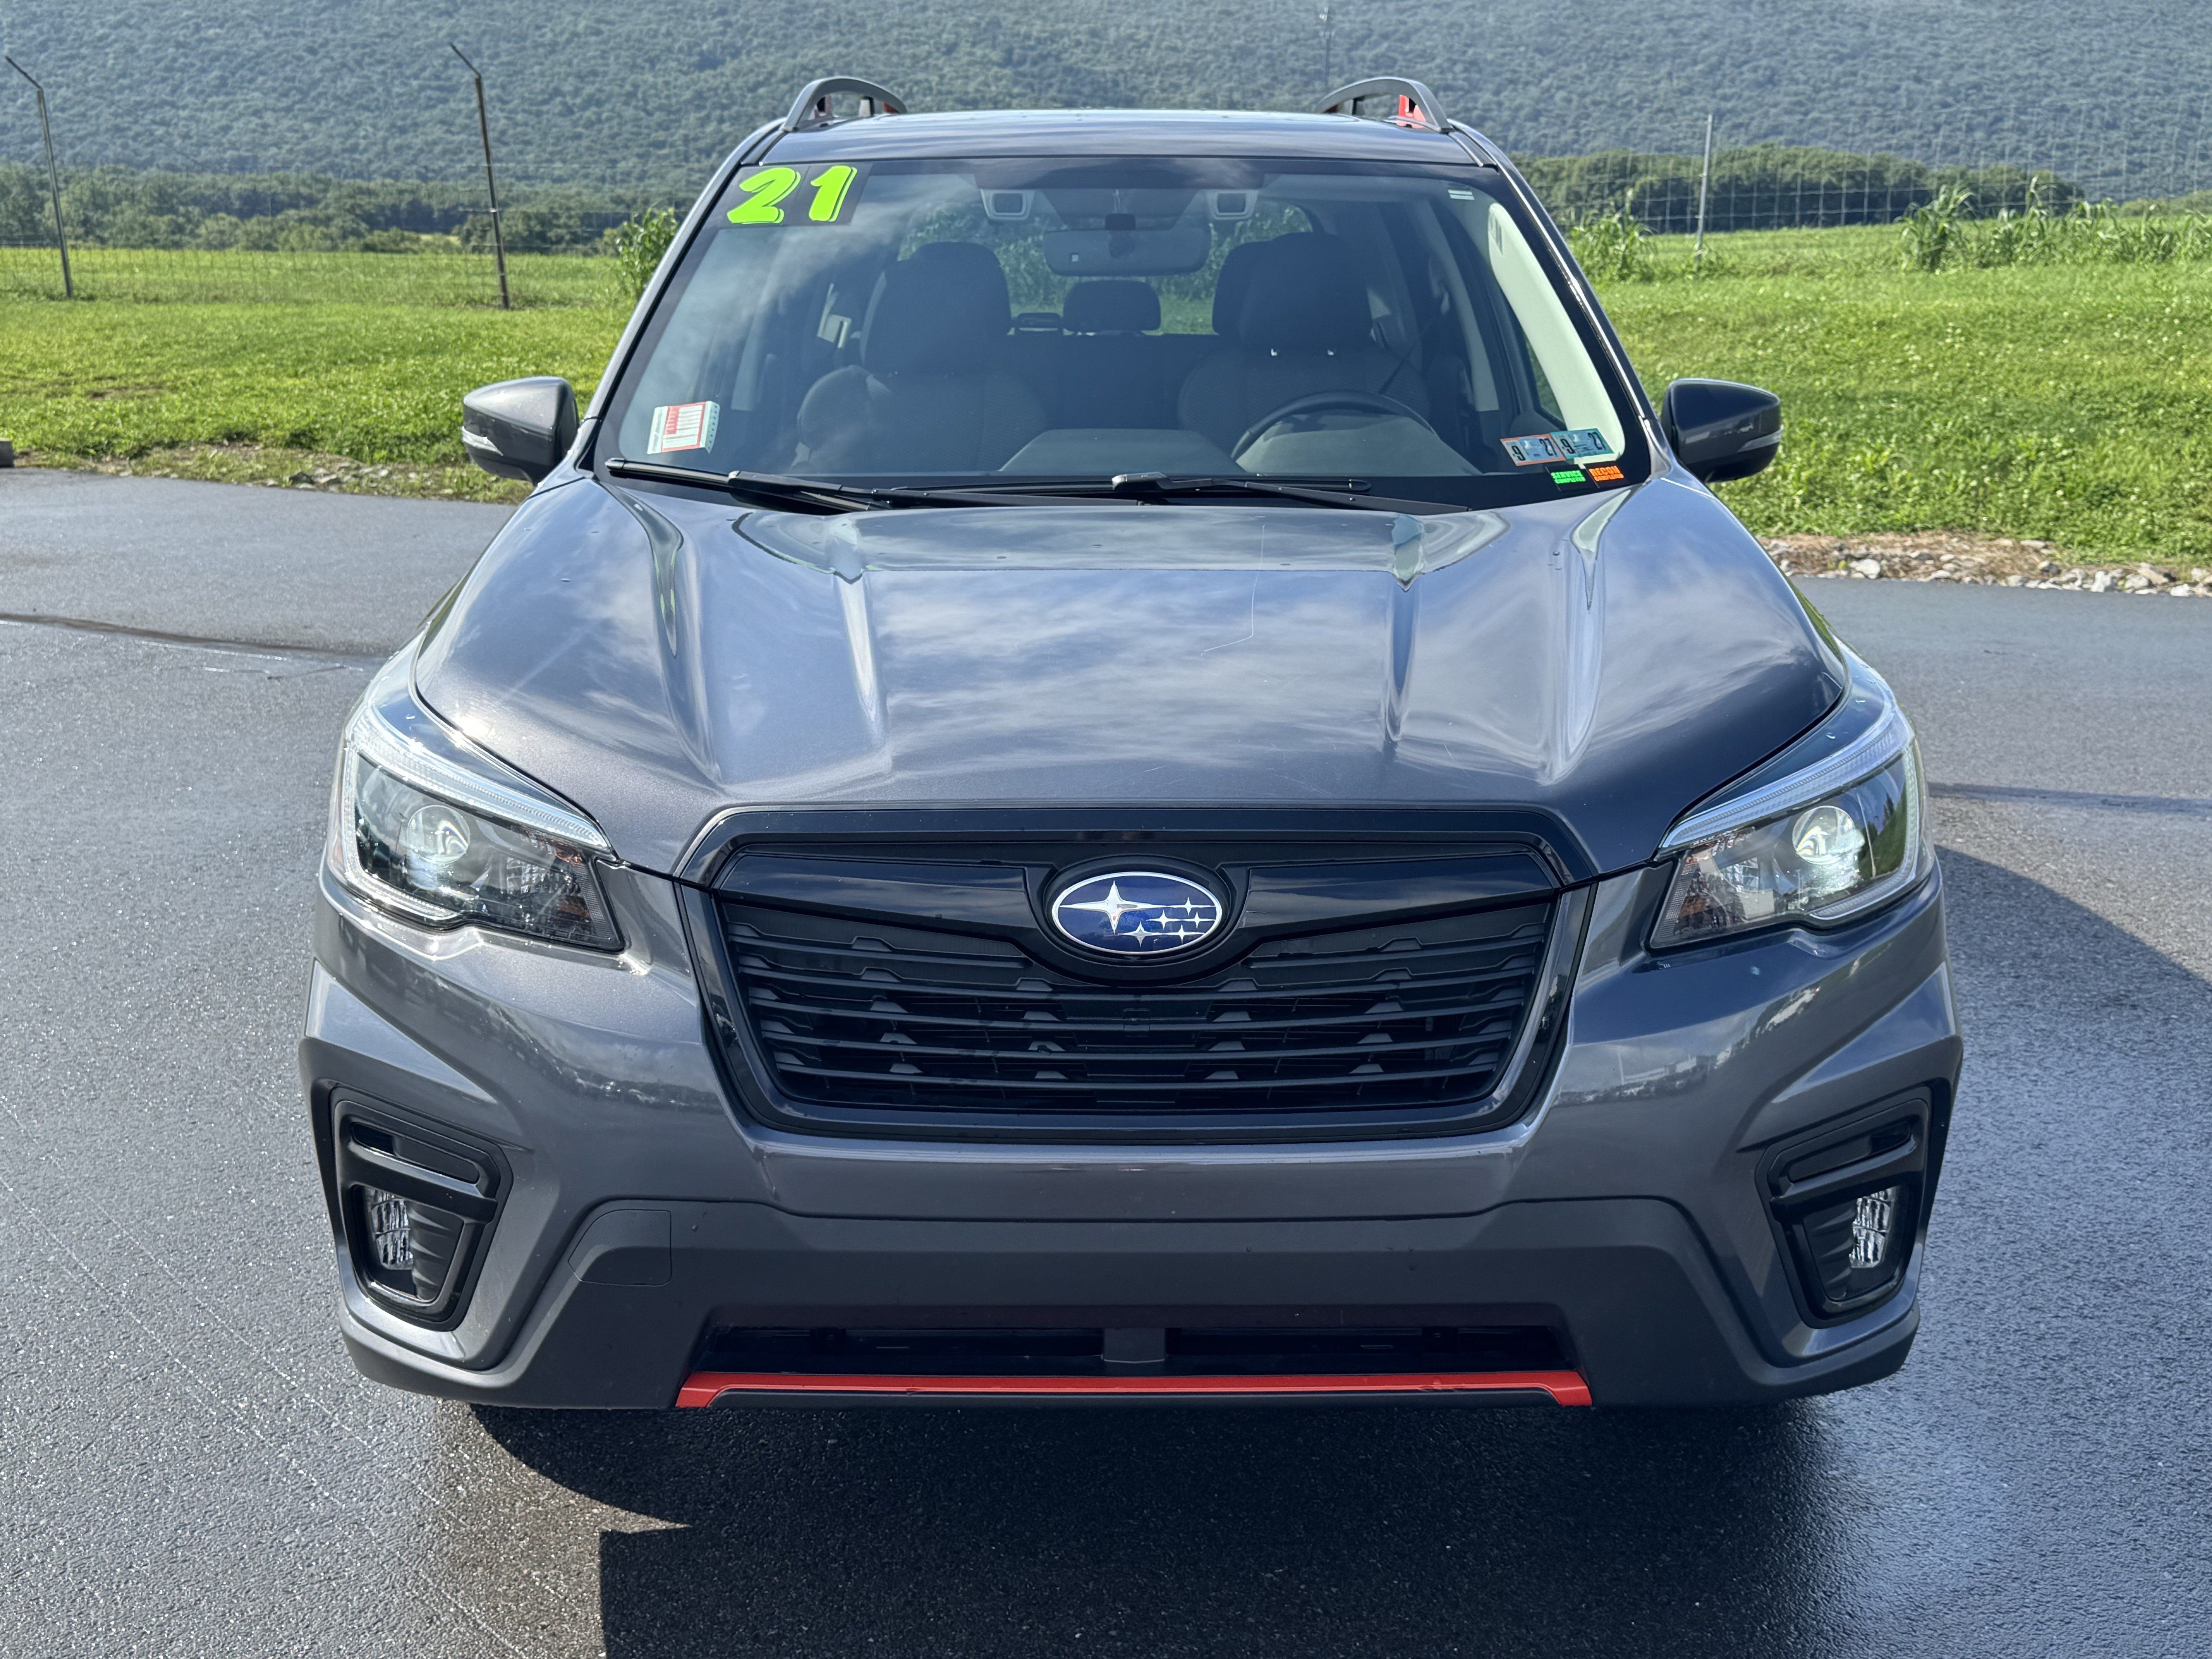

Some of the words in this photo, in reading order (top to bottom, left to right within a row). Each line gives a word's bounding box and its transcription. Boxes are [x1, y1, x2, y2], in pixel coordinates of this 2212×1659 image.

[727, 165, 857, 224] 21
[1512, 445, 1526, 461] 9
[1560, 438, 1575, 454] 9
[1589, 466, 1620, 477] RECON
